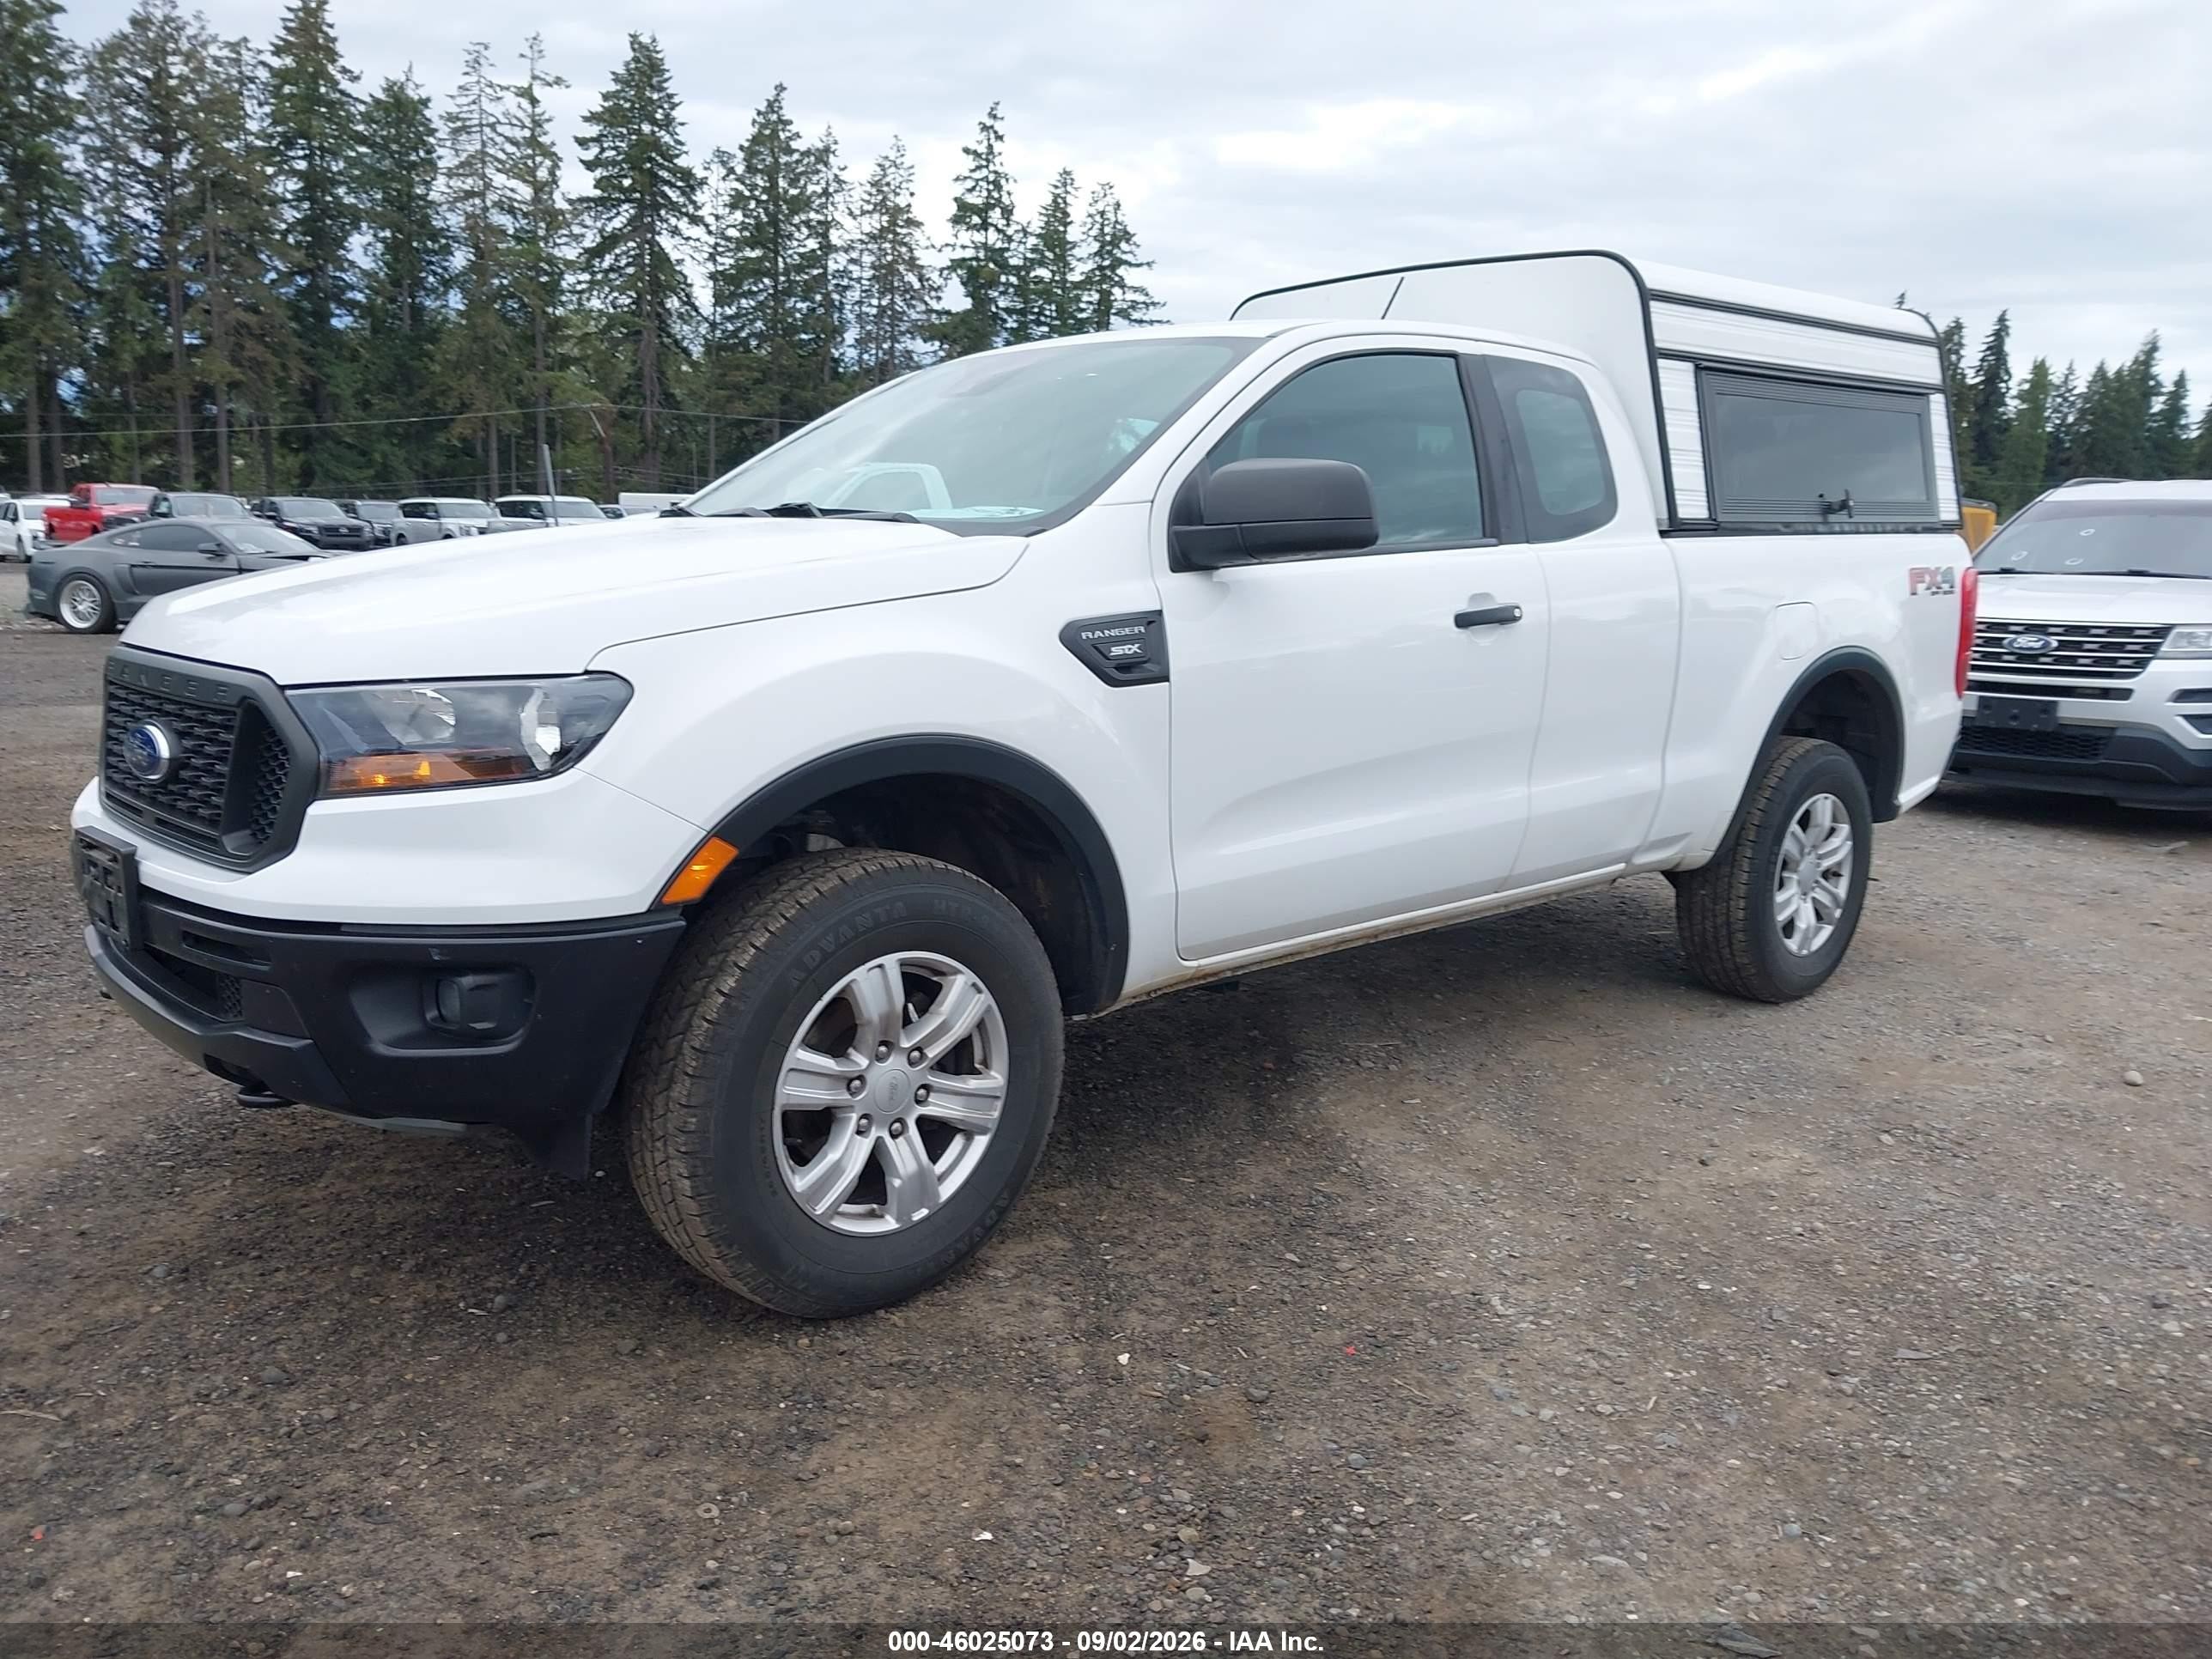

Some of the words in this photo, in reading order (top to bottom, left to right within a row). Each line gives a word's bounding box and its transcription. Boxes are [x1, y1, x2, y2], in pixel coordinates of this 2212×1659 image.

[1909, 566, 1955, 596] FX4
[1081, 626, 1146, 640] RANGER
[1109, 643, 1143, 656] STX
